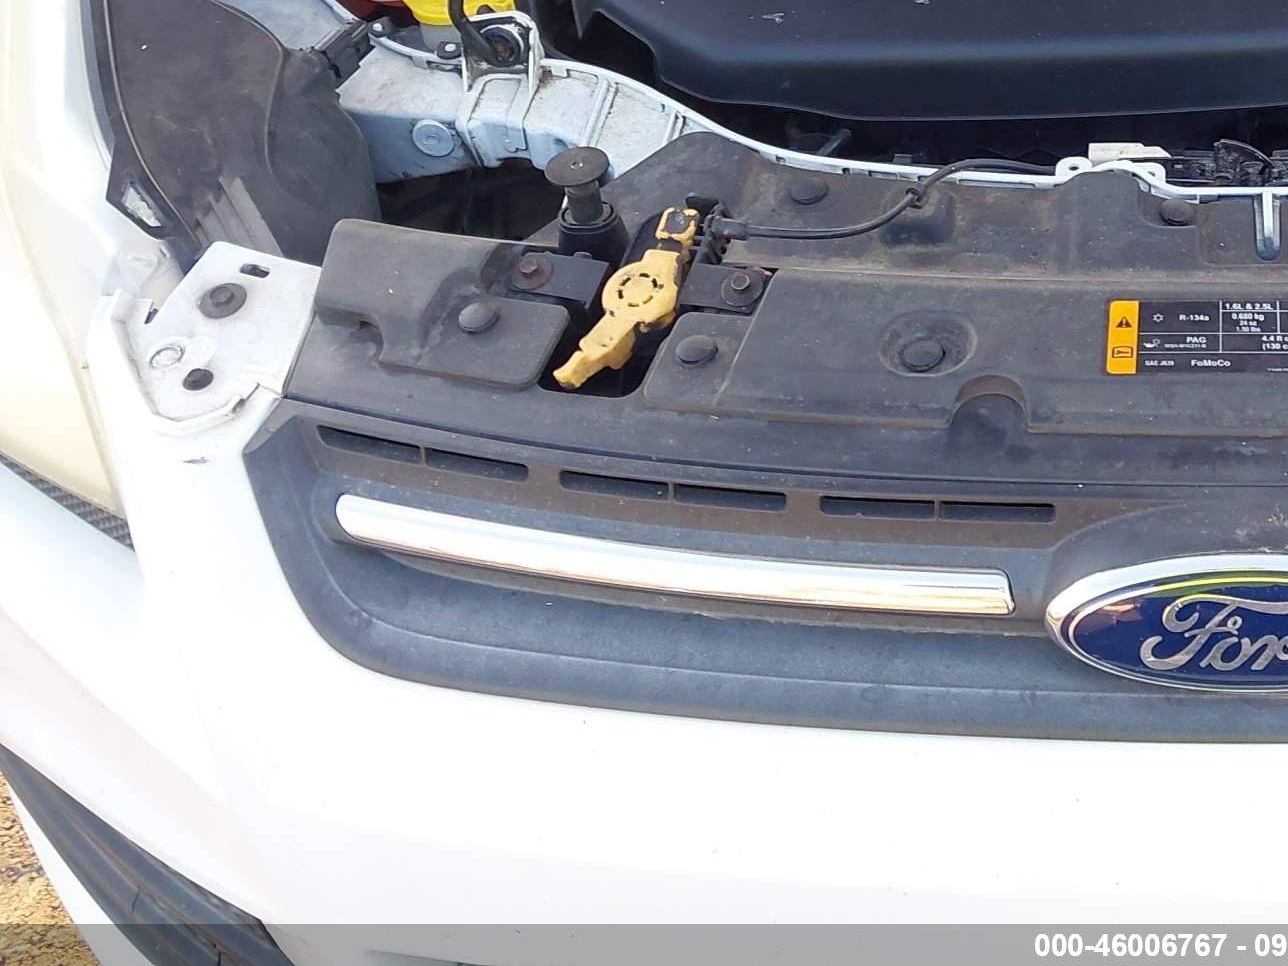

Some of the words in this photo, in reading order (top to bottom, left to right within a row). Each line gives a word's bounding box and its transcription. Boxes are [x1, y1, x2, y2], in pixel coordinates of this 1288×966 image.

[1225, 302, 1244, 310] 1.6L
[1245, 302, 1253, 310] &
[1254, 302, 1274, 310] 2.5L
[1253, 312, 1265, 321] kg
[1262, 342, 1281, 350] (130
[1190, 359, 1231, 367] FoMoCo
